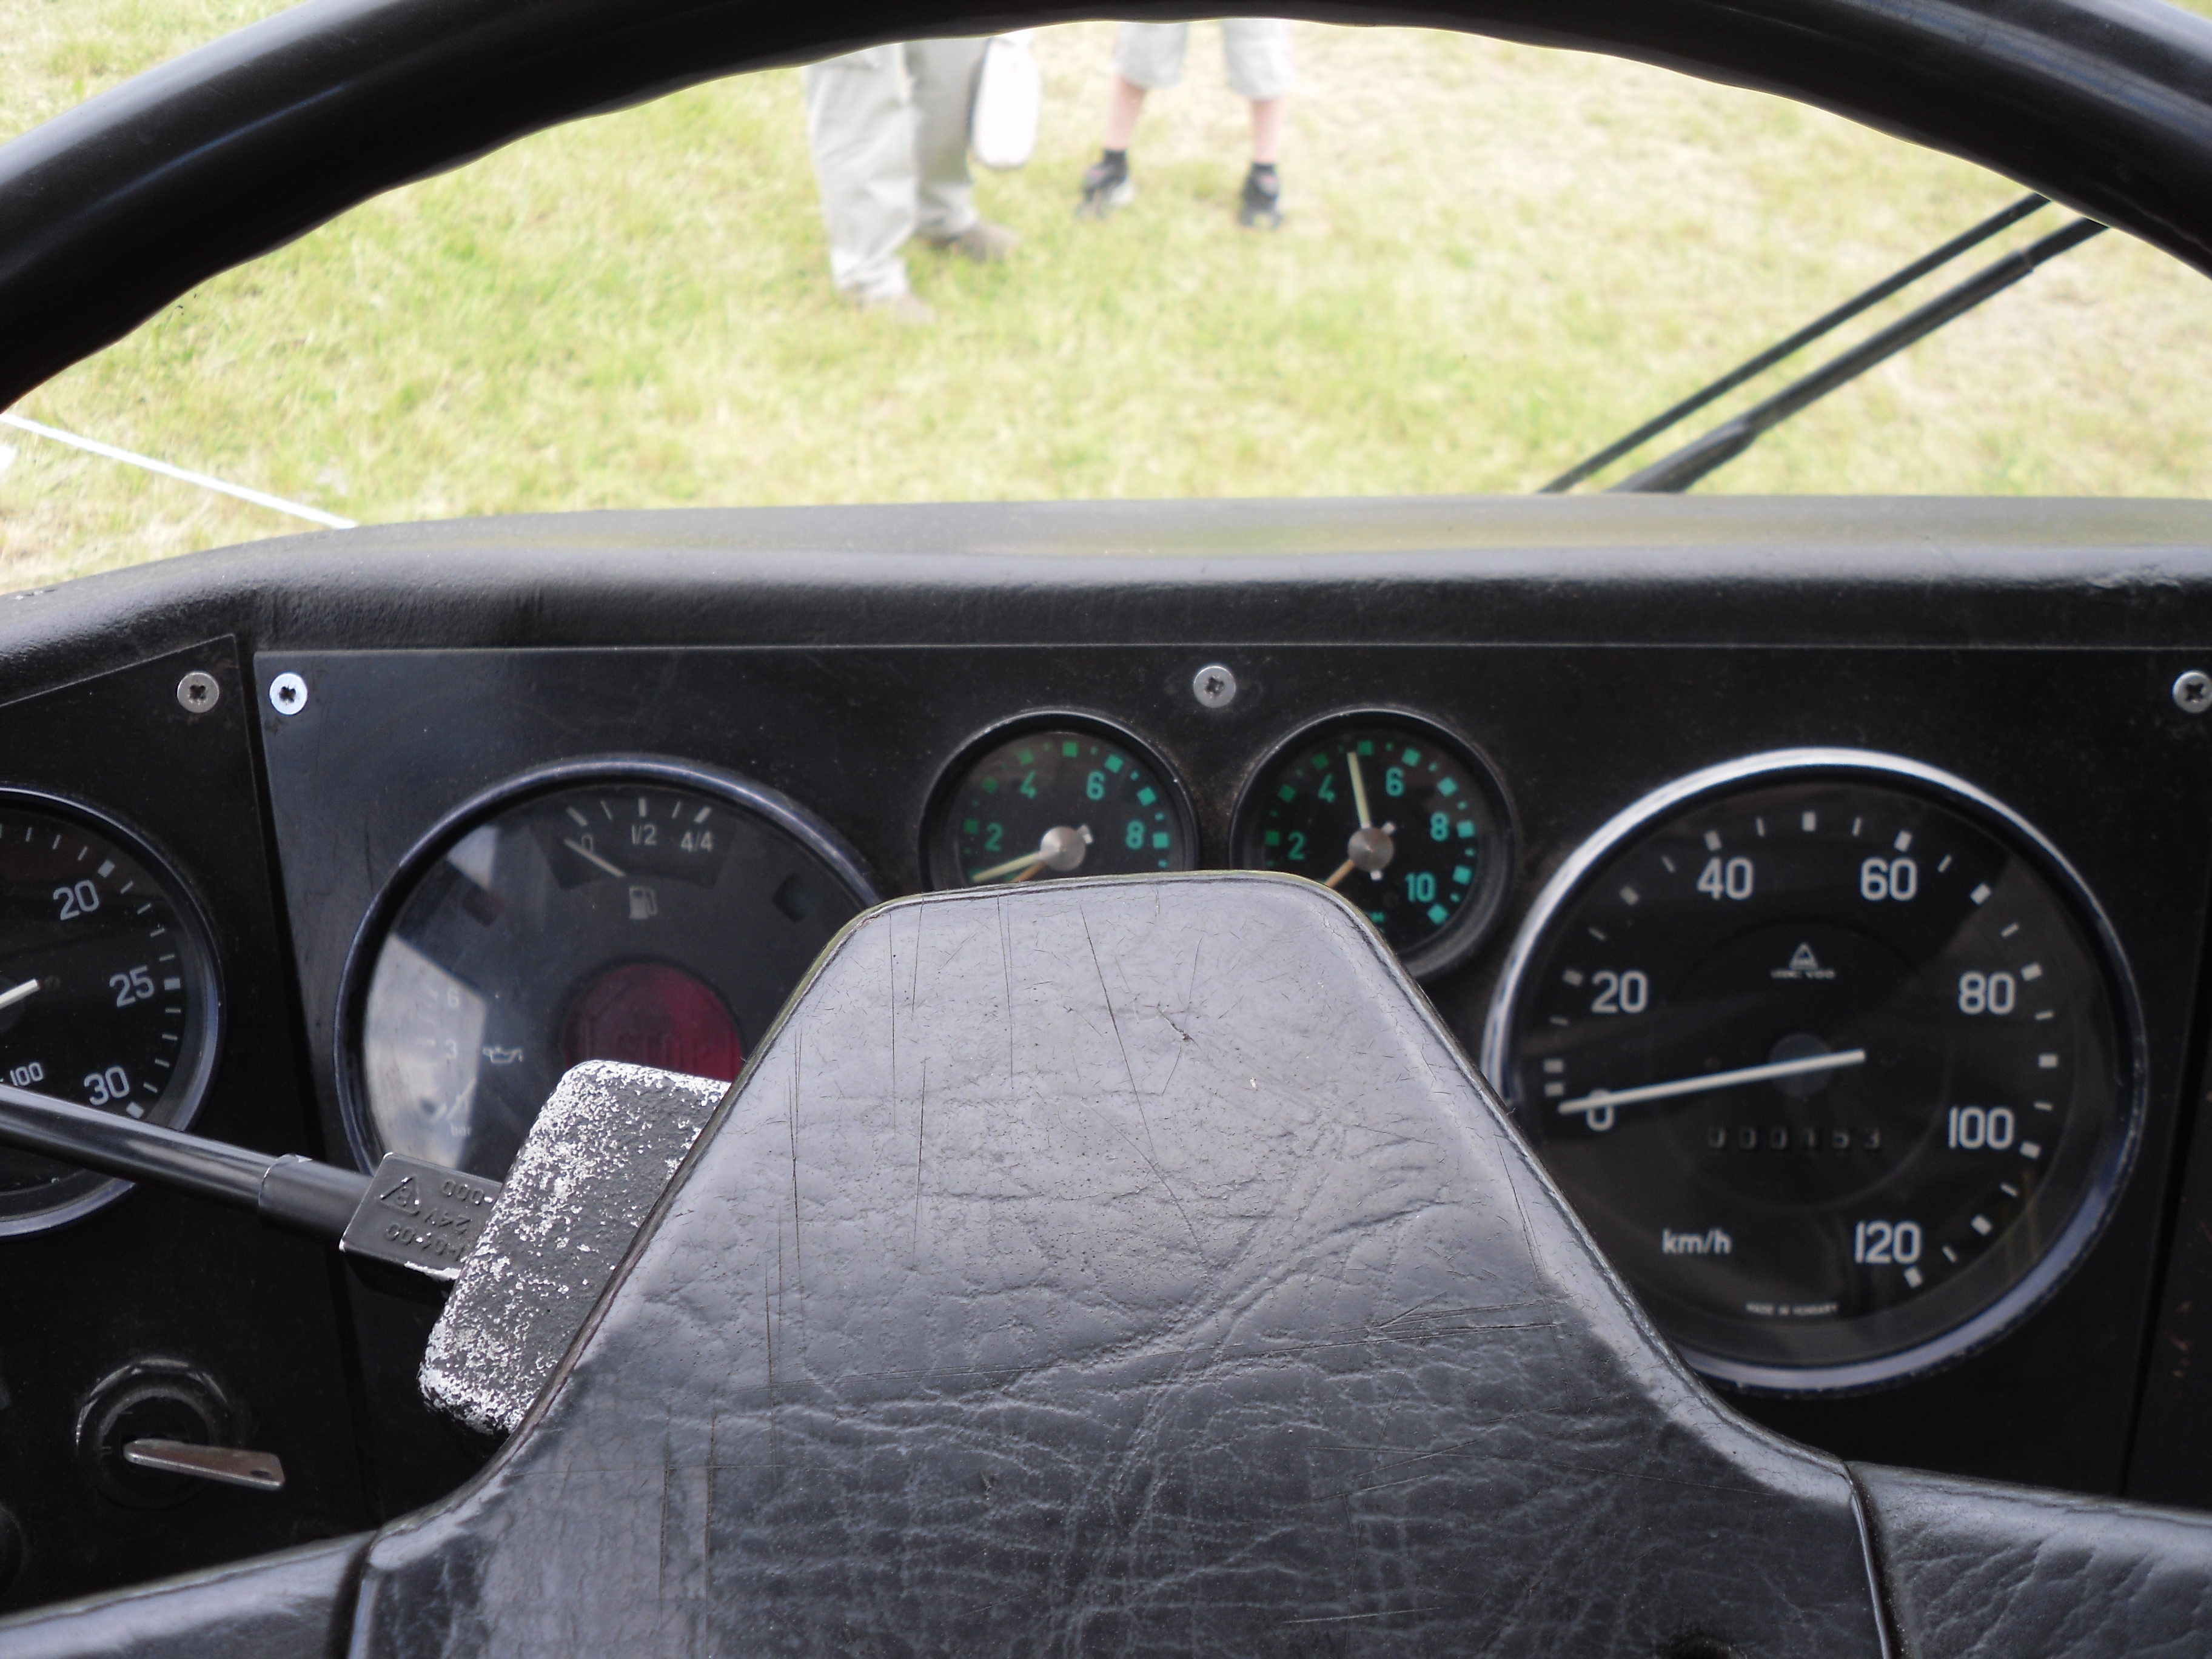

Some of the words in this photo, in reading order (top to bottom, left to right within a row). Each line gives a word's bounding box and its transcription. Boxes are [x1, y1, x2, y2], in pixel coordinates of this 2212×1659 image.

[1019, 769, 1037, 799] 4
[1087, 769, 1106, 801] 6
[1318, 773, 1336, 803] 4
[1386, 766, 1404, 797] 6
[631, 823, 658, 846] 1/2
[681, 831, 714, 853] 4/4
[985, 822, 1003, 851] 2
[1125, 820, 1145, 850] 8
[1430, 811, 1449, 842] 8
[1288, 831, 1306, 860] 2
[1405, 872, 1436, 903] 10
[1697, 857, 1754, 900] 40
[1860, 857, 1918, 900] 60
[53, 879, 99, 921] 20
[109, 964, 155, 1007] 25
[1591, 971, 1648, 1013] 20
[1958, 972, 2016, 1014] 80
[444, 1039, 457, 1061] 3
[83, 1065, 130, 1106] 30
[1586, 1088, 1615, 1133] 0
[1948, 1107, 2014, 1149] 100
[1661, 1228, 1732, 1254] km/h
[1854, 1221, 1922, 1264] 120
